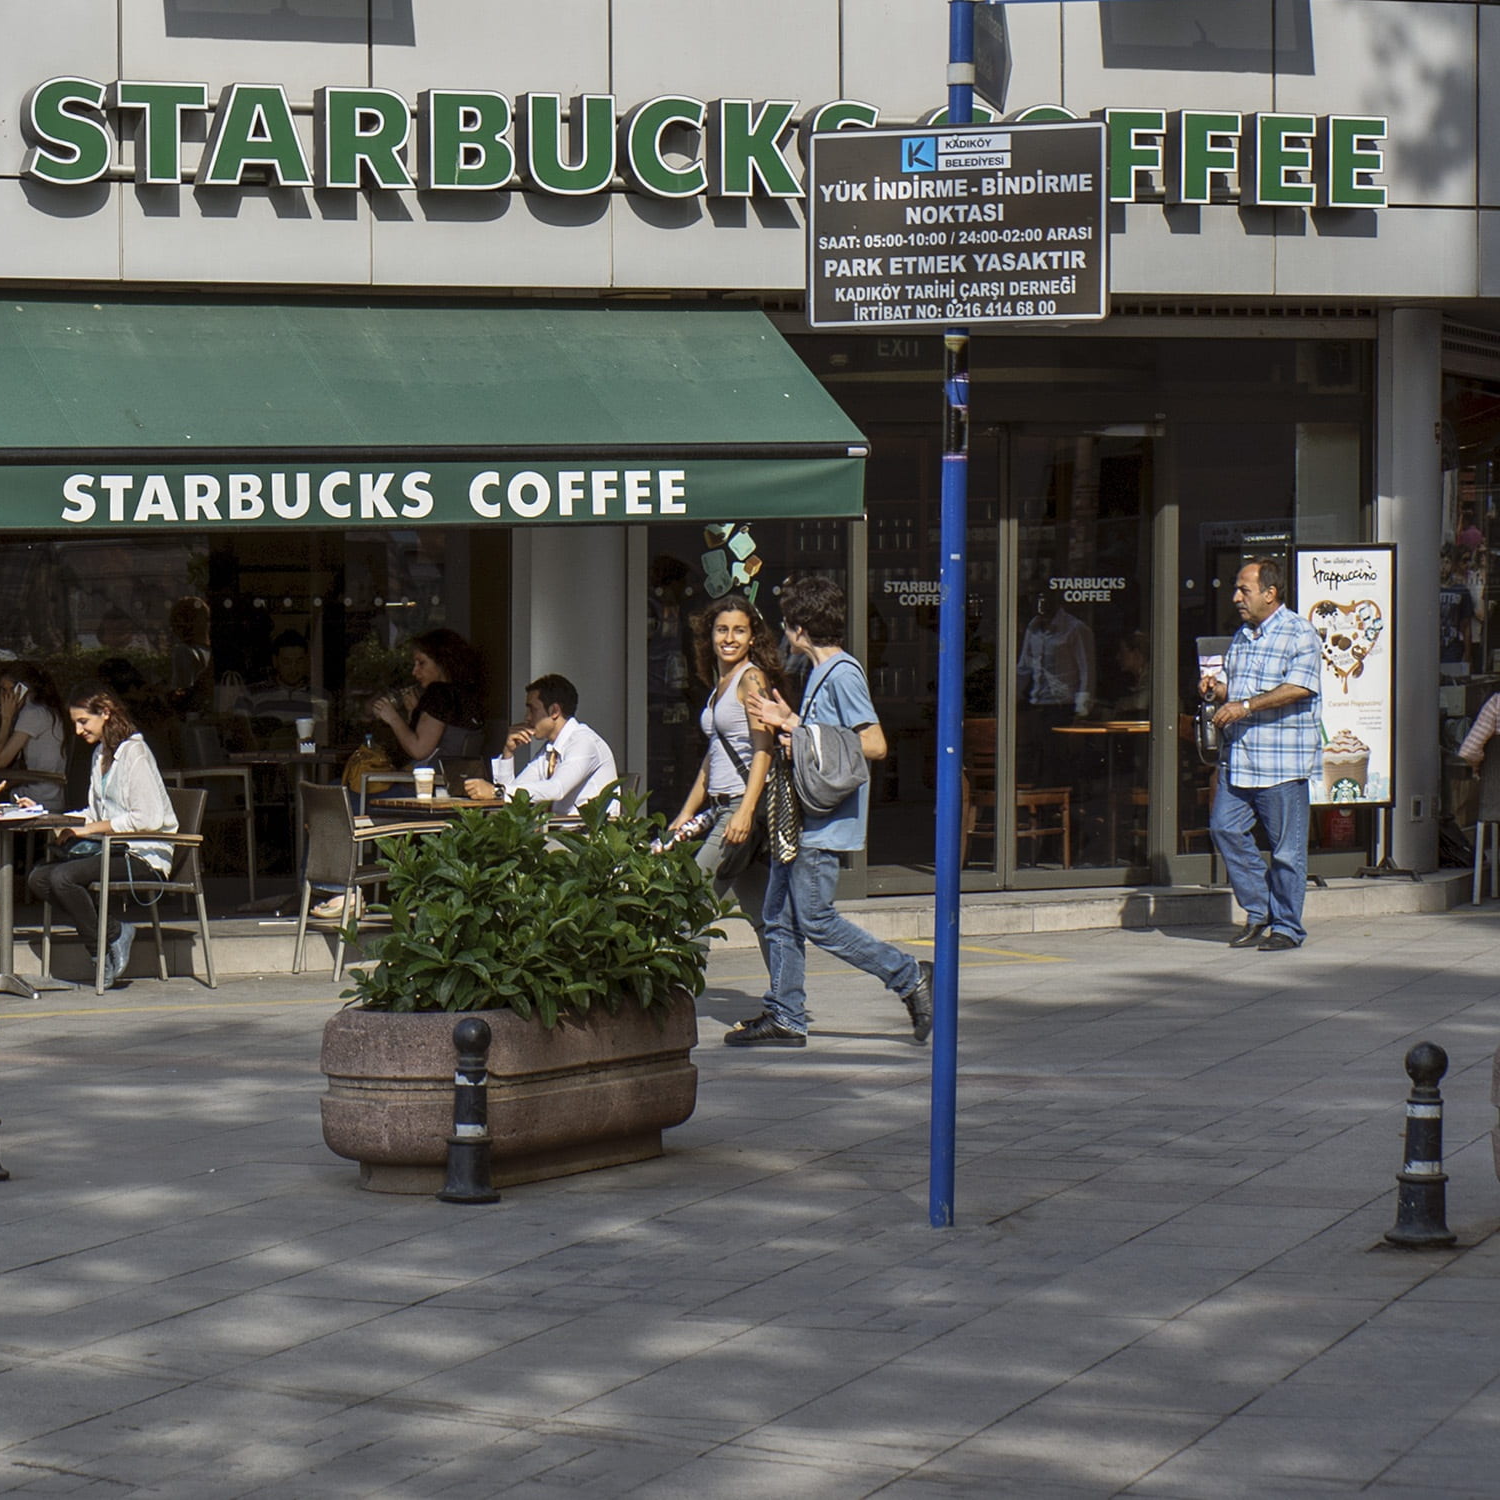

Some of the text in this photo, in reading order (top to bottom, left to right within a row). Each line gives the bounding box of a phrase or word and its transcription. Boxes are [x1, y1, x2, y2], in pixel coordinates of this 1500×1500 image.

[922, 102, 1389, 208] FFEE
[945, 138, 991, 150] KADIKÖY
[945, 154, 1005, 168] BELEDİYESİ
[820, 180, 867, 202] YÜK
[906, 203, 1004, 225] NOKTASI
[819, 235, 861, 250] SAAT:
[864, 232, 947, 248] 05:00-10:00
[959, 228, 1042, 244] 24:00-02:00
[1046, 226, 1092, 241] ARASI
[824, 250, 1087, 278] PARK ETMEK YASAKTIR
[835, 274, 1077, 301] KADIKÖY TARİHİ ÇARŞI DERNEĞİ
[854, 299, 1056, 321] İRTİBAT NO: 0216 414 68 00
[61, 468, 687, 523] STARBUCKS COFFEE
[883, 580, 941, 593] STARBU
[1049, 577, 1126, 590] STARBUCKS
[898, 593, 941, 606] COFFE
[1064, 590, 1111, 602] COFFEE
